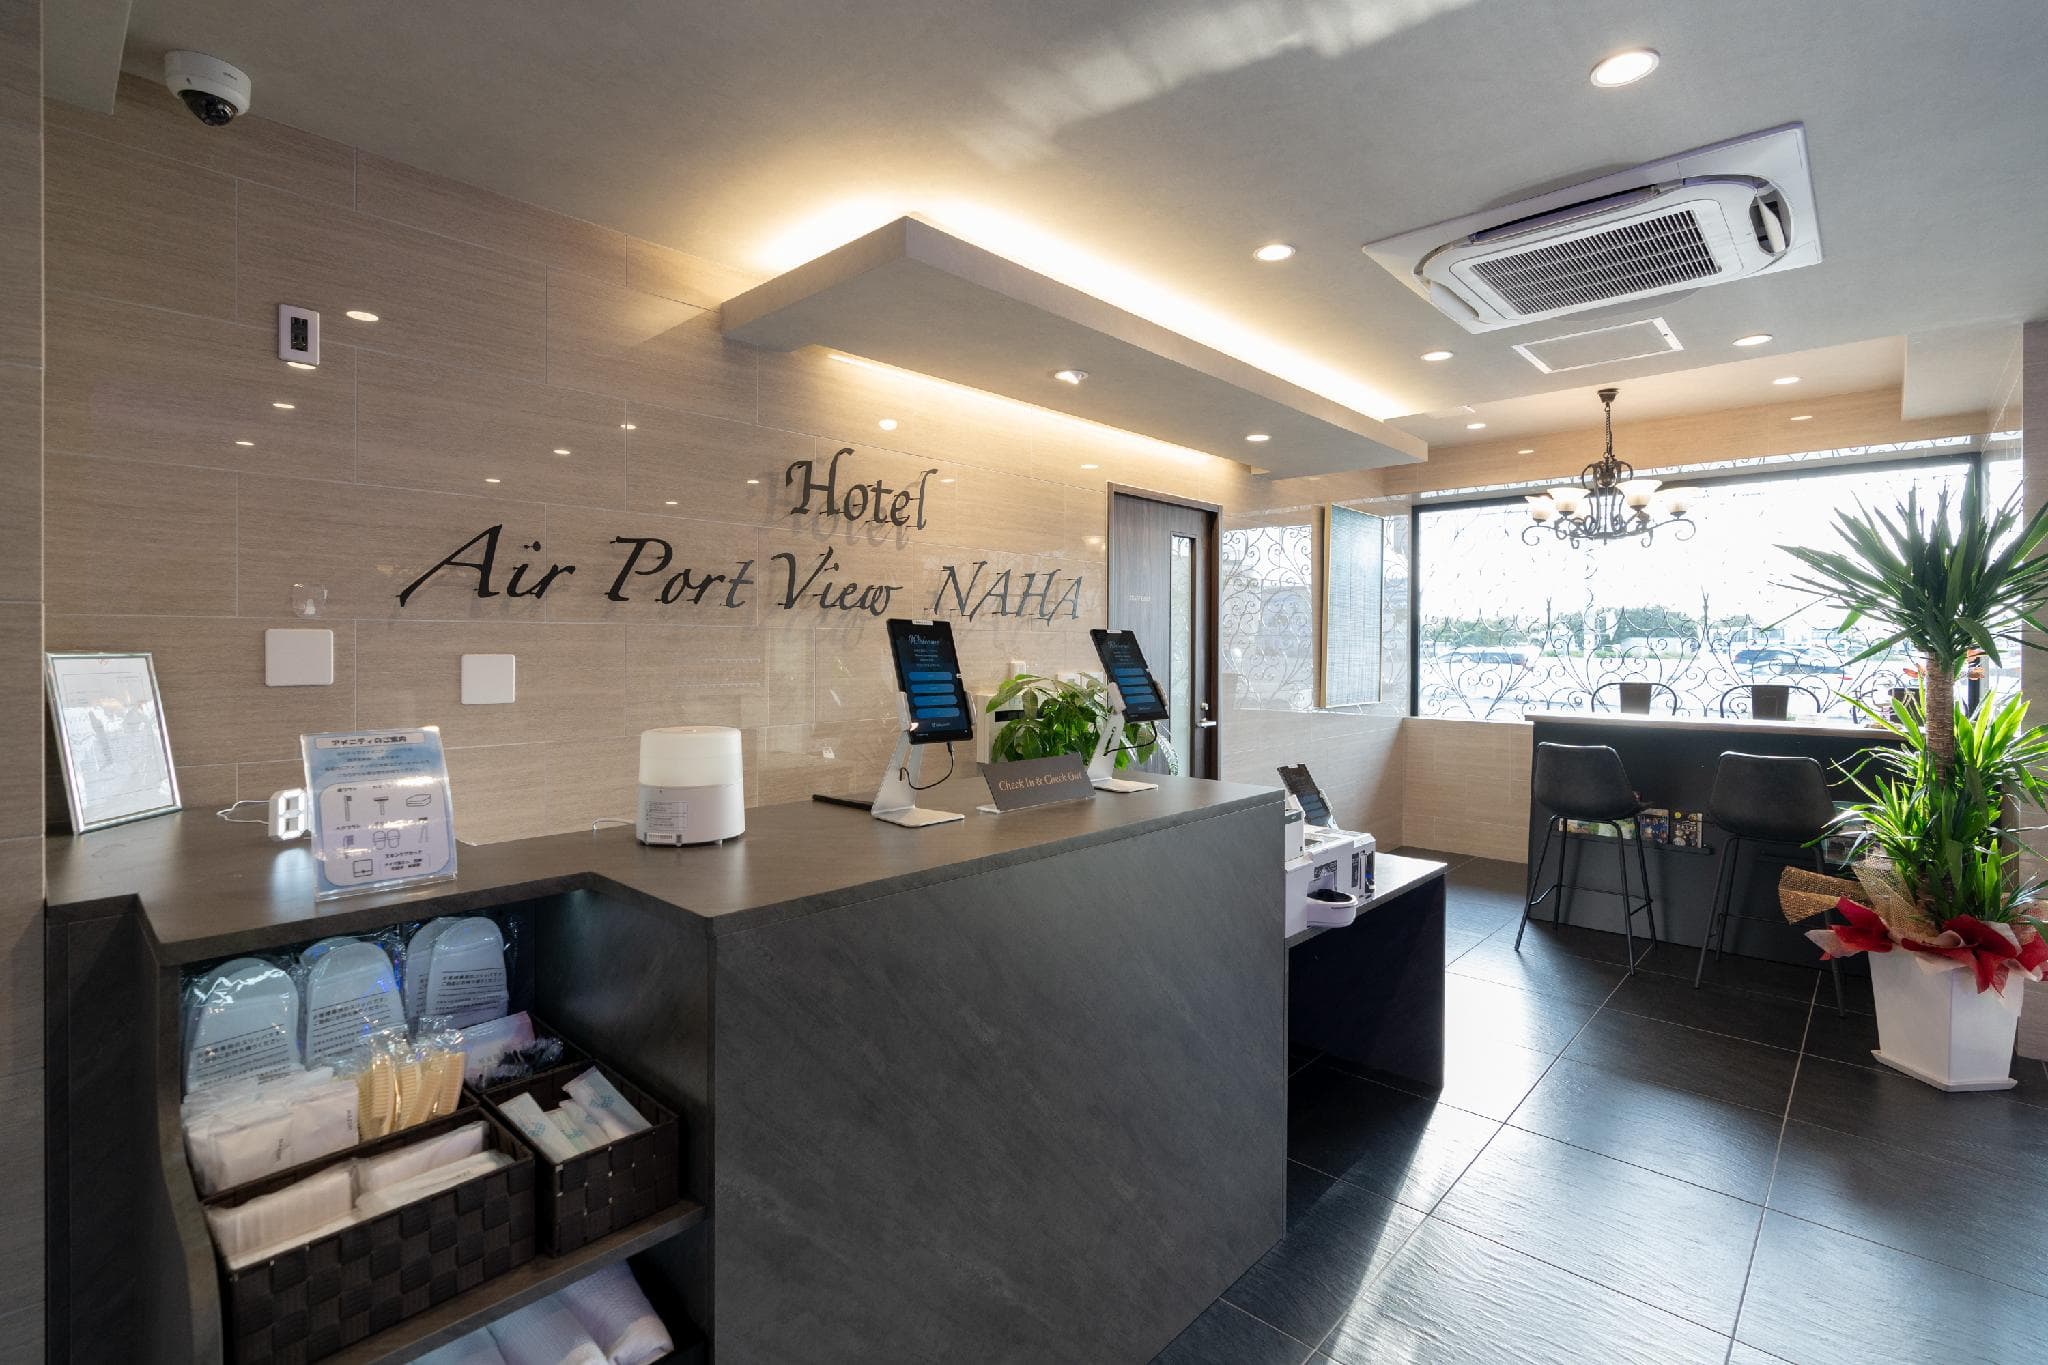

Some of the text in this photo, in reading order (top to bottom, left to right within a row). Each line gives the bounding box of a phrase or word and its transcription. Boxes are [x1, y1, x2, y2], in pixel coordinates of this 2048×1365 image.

[785, 447, 938, 531] Hotel
[398, 523, 1084, 627] Air Port View NAHA
[998, 771, 1082, 791] Check In & Check Out
